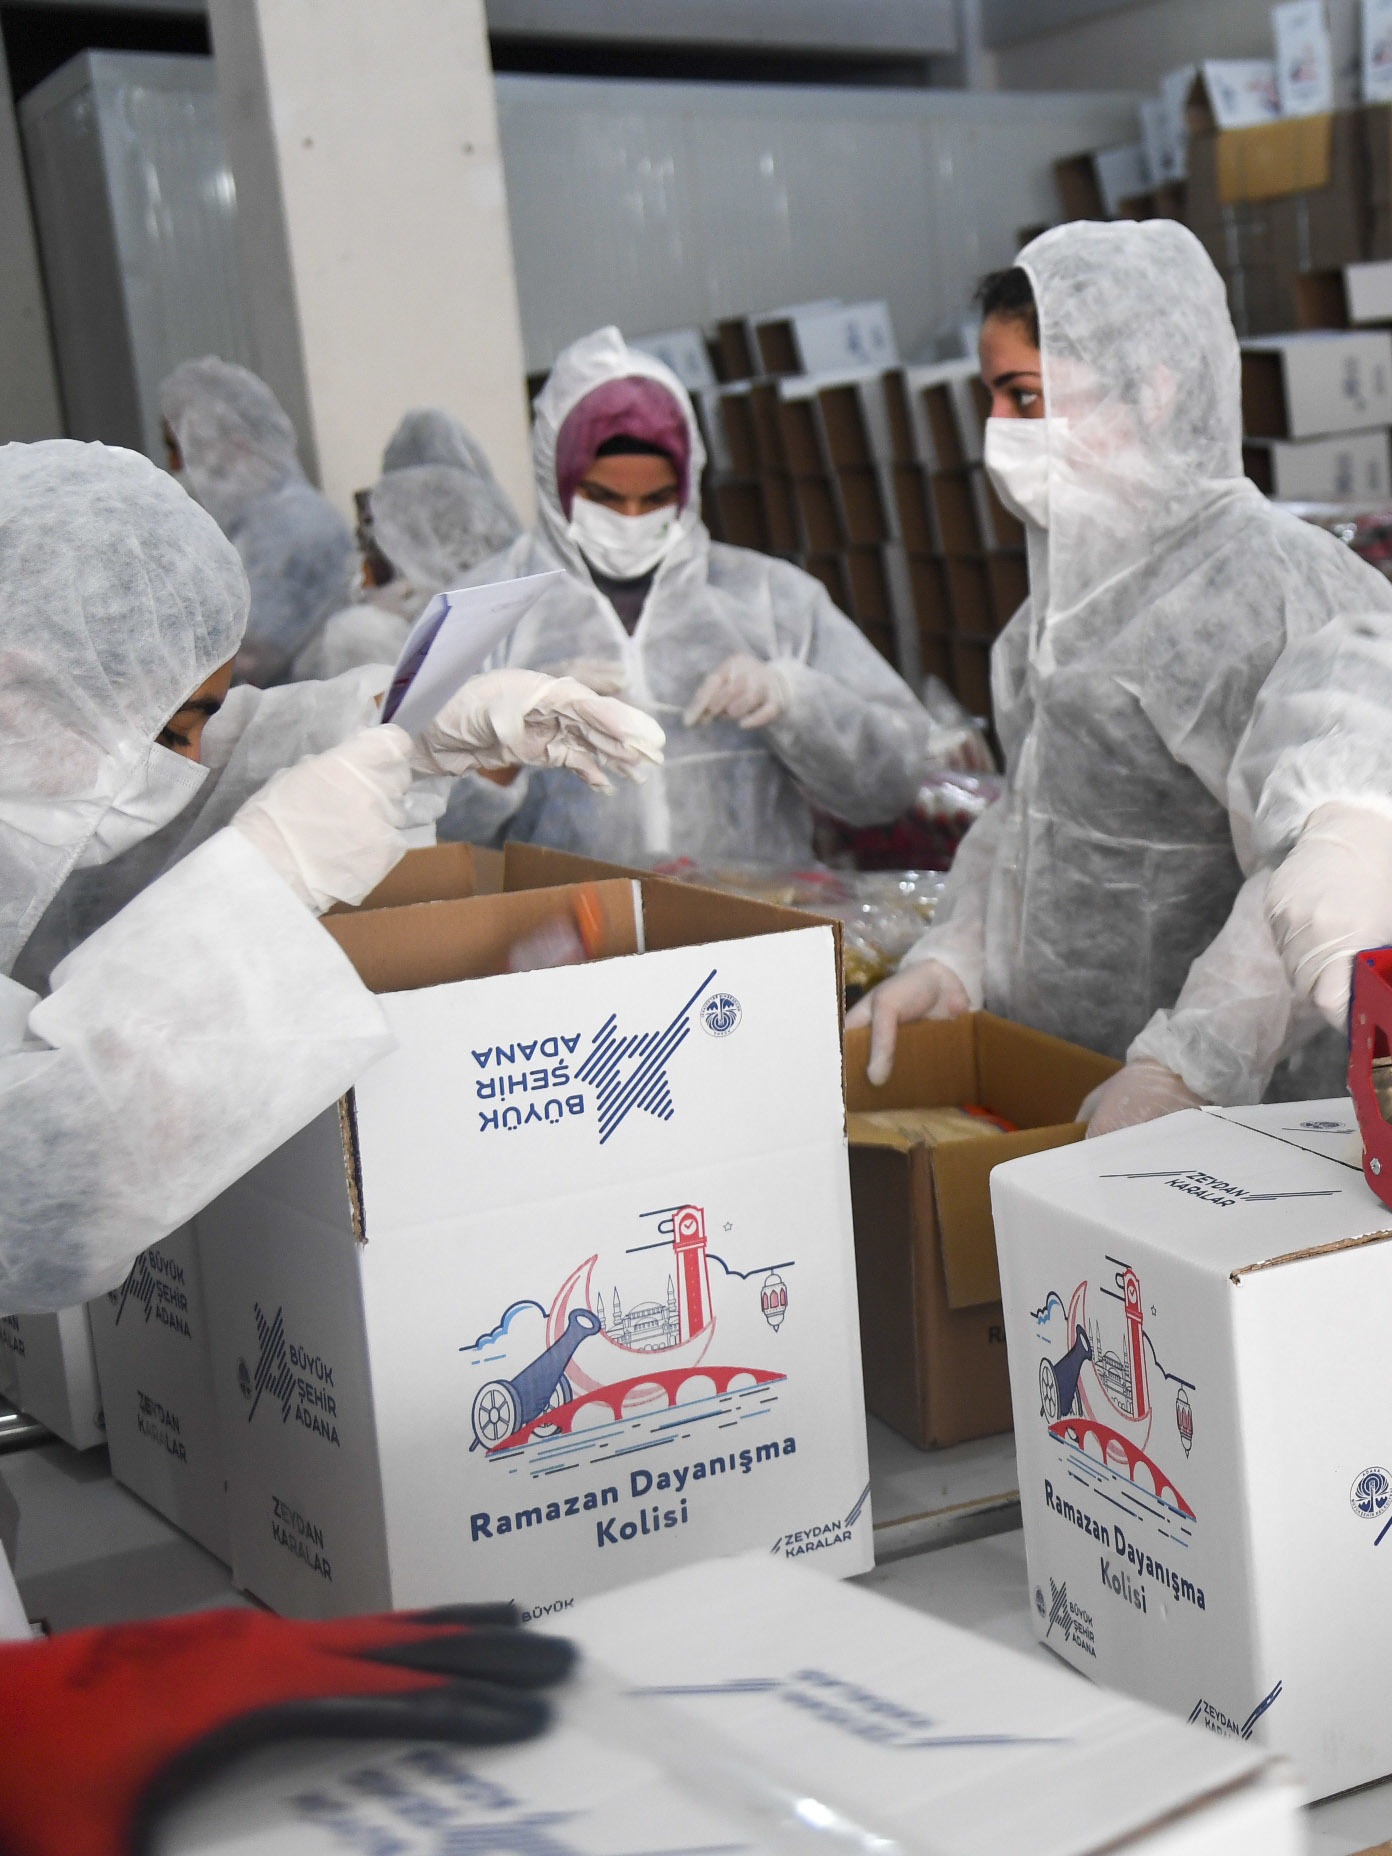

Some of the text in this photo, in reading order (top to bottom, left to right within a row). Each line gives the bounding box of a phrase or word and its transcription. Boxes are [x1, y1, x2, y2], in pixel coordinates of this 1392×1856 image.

[471, 1032, 581, 1070] ADANA
[475, 1059, 571, 1100] ŞEHİR
[479, 1094, 584, 1132] BÜYÜK
[1164, 1178, 1236, 1207] KARALAR
[1186, 1172, 1249, 1197] ZEYDAN
[156, 1304, 191, 1340] ADANA
[290, 1344, 334, 1388] BÜYÜK
[298, 1377, 337, 1418] ŞEHİR
[295, 1404, 341, 1448] ADANA
[469, 1436, 797, 1542] Ramazan Dayanışma
[271, 1496, 324, 1550] ZEYDAN
[596, 1500, 690, 1547] Kolisi
[784, 1520, 841, 1546] ZEYDAN
[272, 1521, 333, 1582] KARALAR
[785, 1530, 852, 1557] KARALAR
[1044, 1478, 1206, 1611] Ramazan Dayanışma
[1100, 1557, 1147, 1614] Kolisi
[521, 1598, 574, 1623] BÜYÜK
[1072, 1633, 1097, 1659] ADANA
[1203, 1700, 1240, 1736] ZEYDAN
